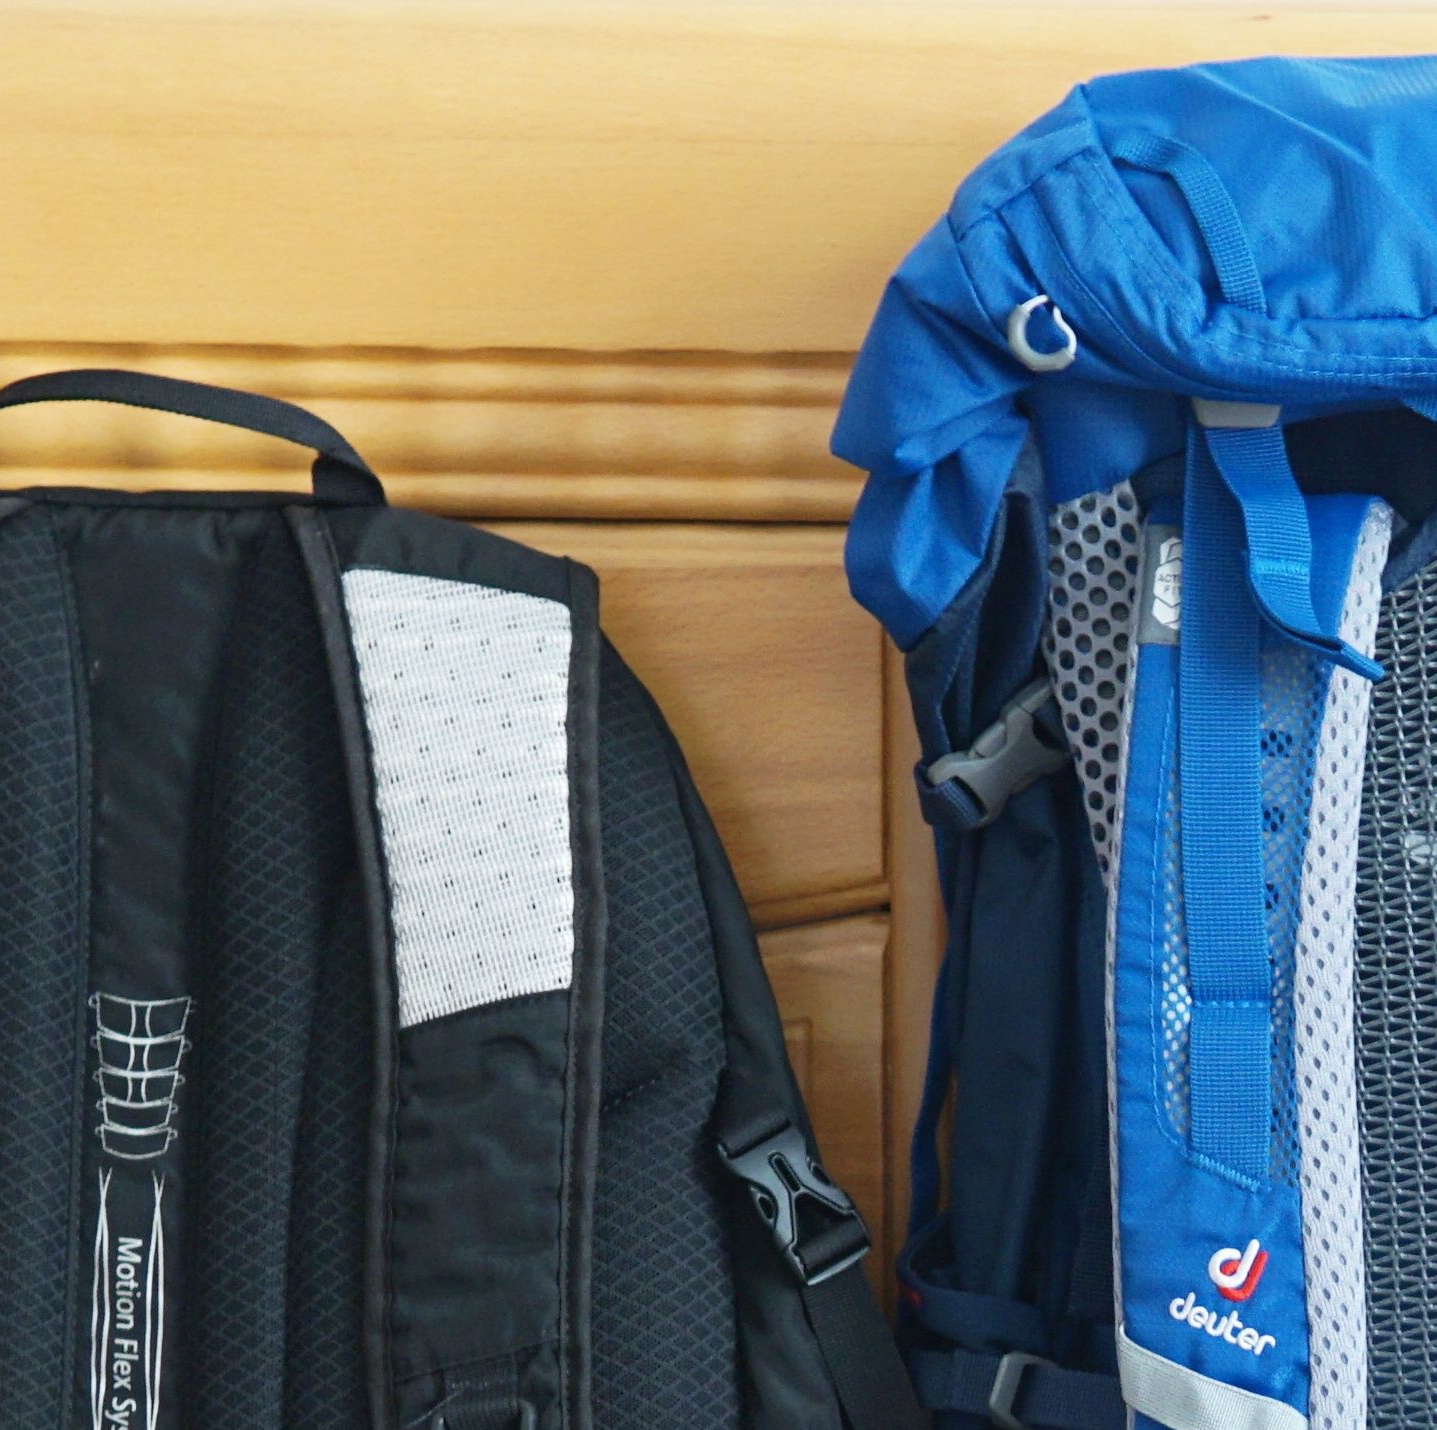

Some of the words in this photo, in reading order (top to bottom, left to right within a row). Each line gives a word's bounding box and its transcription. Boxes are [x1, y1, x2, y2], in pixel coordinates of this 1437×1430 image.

[115, 1236, 143, 1330] Motion
[1169, 1291, 1276, 1356] deuter
[113, 1338, 139, 1391] Flex
